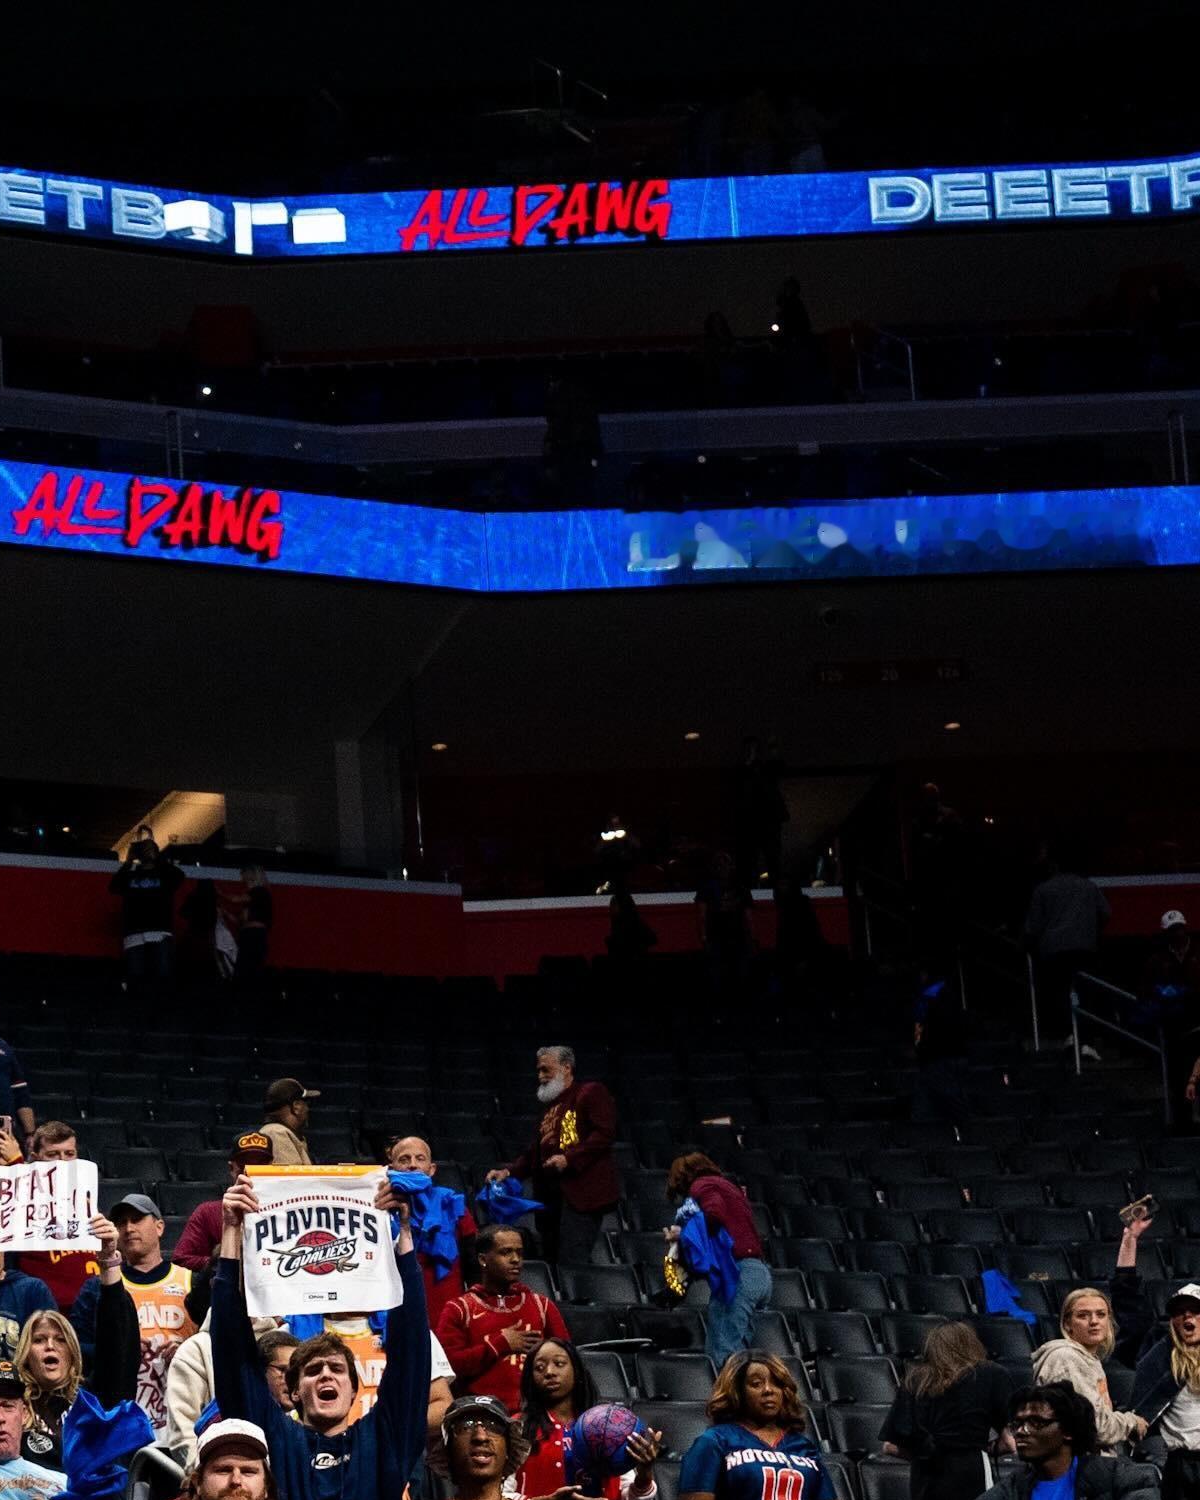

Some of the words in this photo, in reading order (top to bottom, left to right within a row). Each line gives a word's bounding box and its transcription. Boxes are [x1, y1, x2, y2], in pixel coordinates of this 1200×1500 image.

[401, 189, 506, 251] ALL
[508, 179, 670, 245] DAWG
[12, 472, 126, 536] ALL
[124, 480, 284, 560] DAWG
[278, 1240, 356, 1277] CAVALIERS
[725, 1448, 793, 1472] MOTOR
